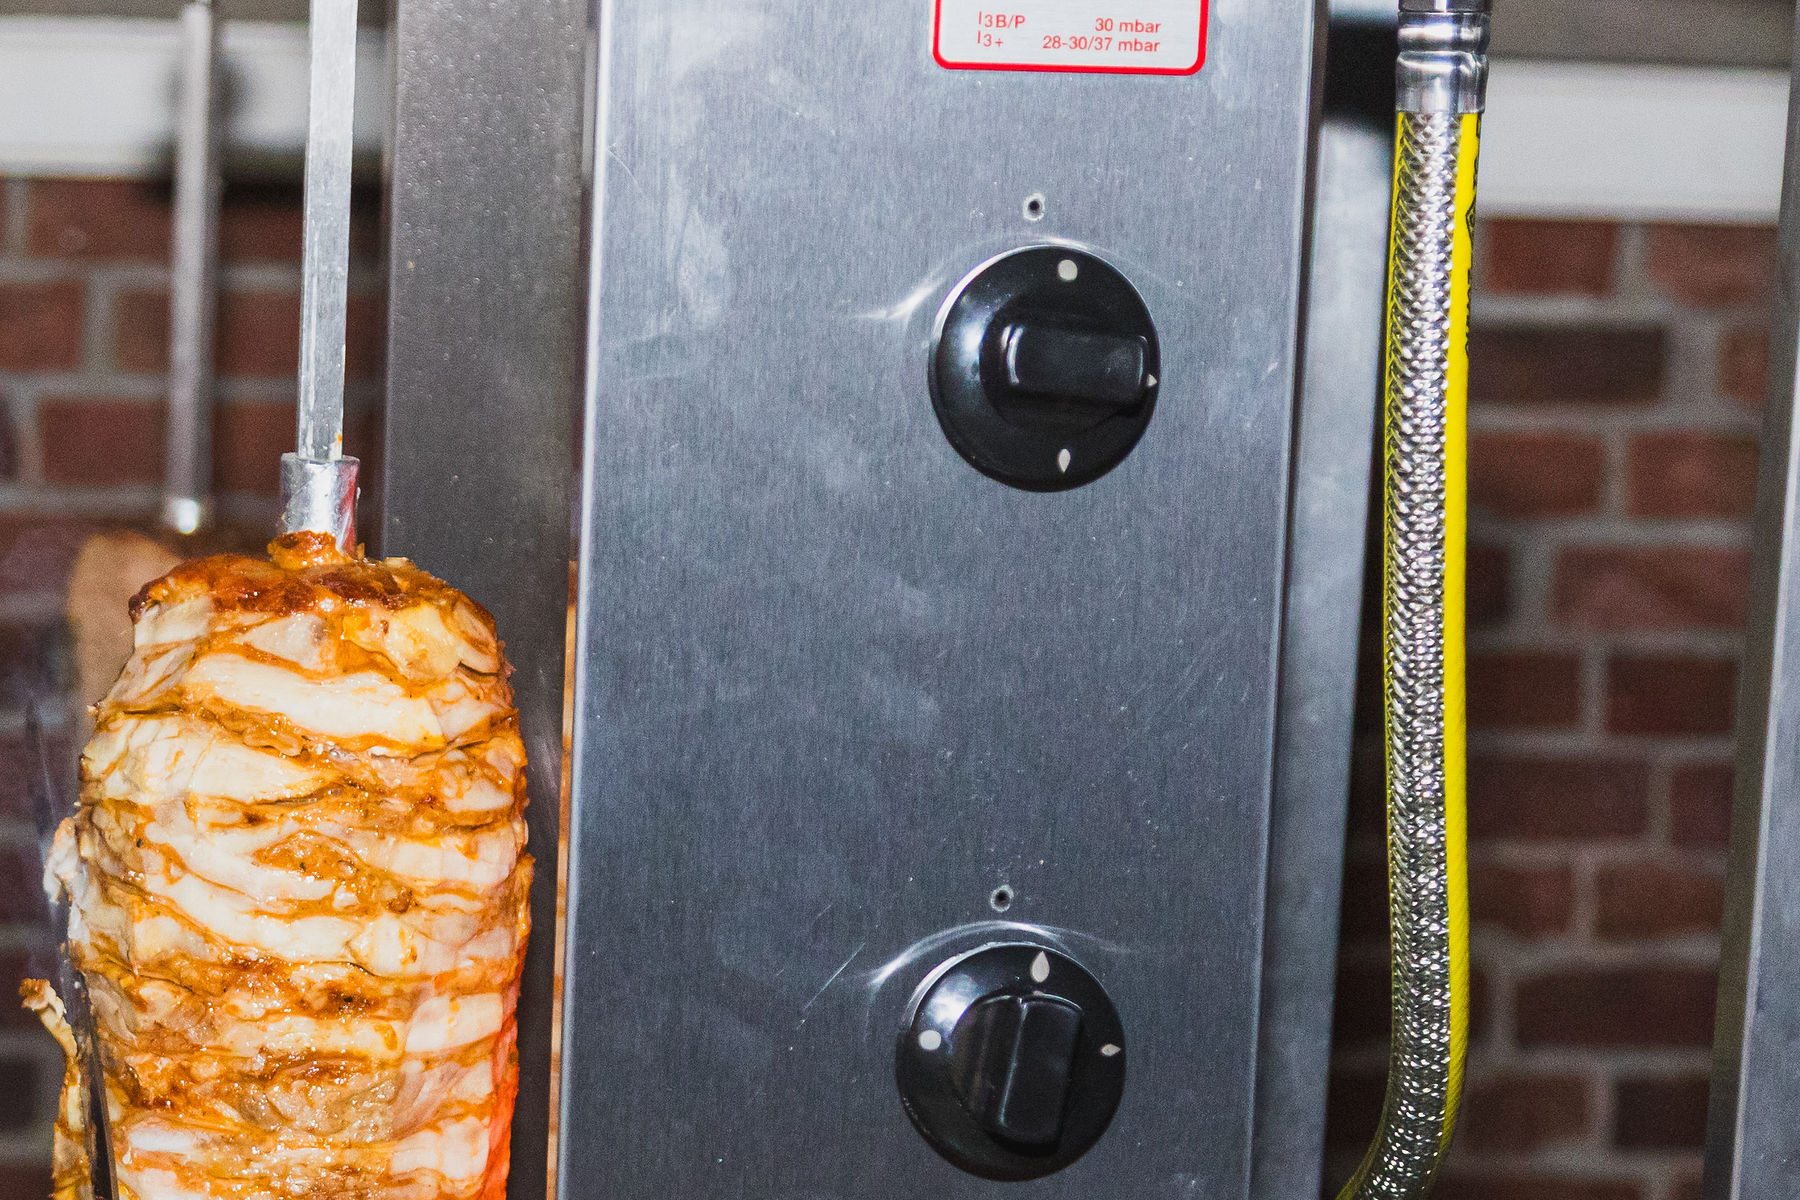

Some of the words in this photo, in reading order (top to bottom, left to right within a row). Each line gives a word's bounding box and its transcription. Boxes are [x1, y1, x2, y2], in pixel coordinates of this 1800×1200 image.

[1095, 17, 1114, 32] 30
[1119, 18, 1162, 33] mbar
[1042, 35, 1113, 51] 28-30/37
[1118, 38, 1160, 52] mbar
